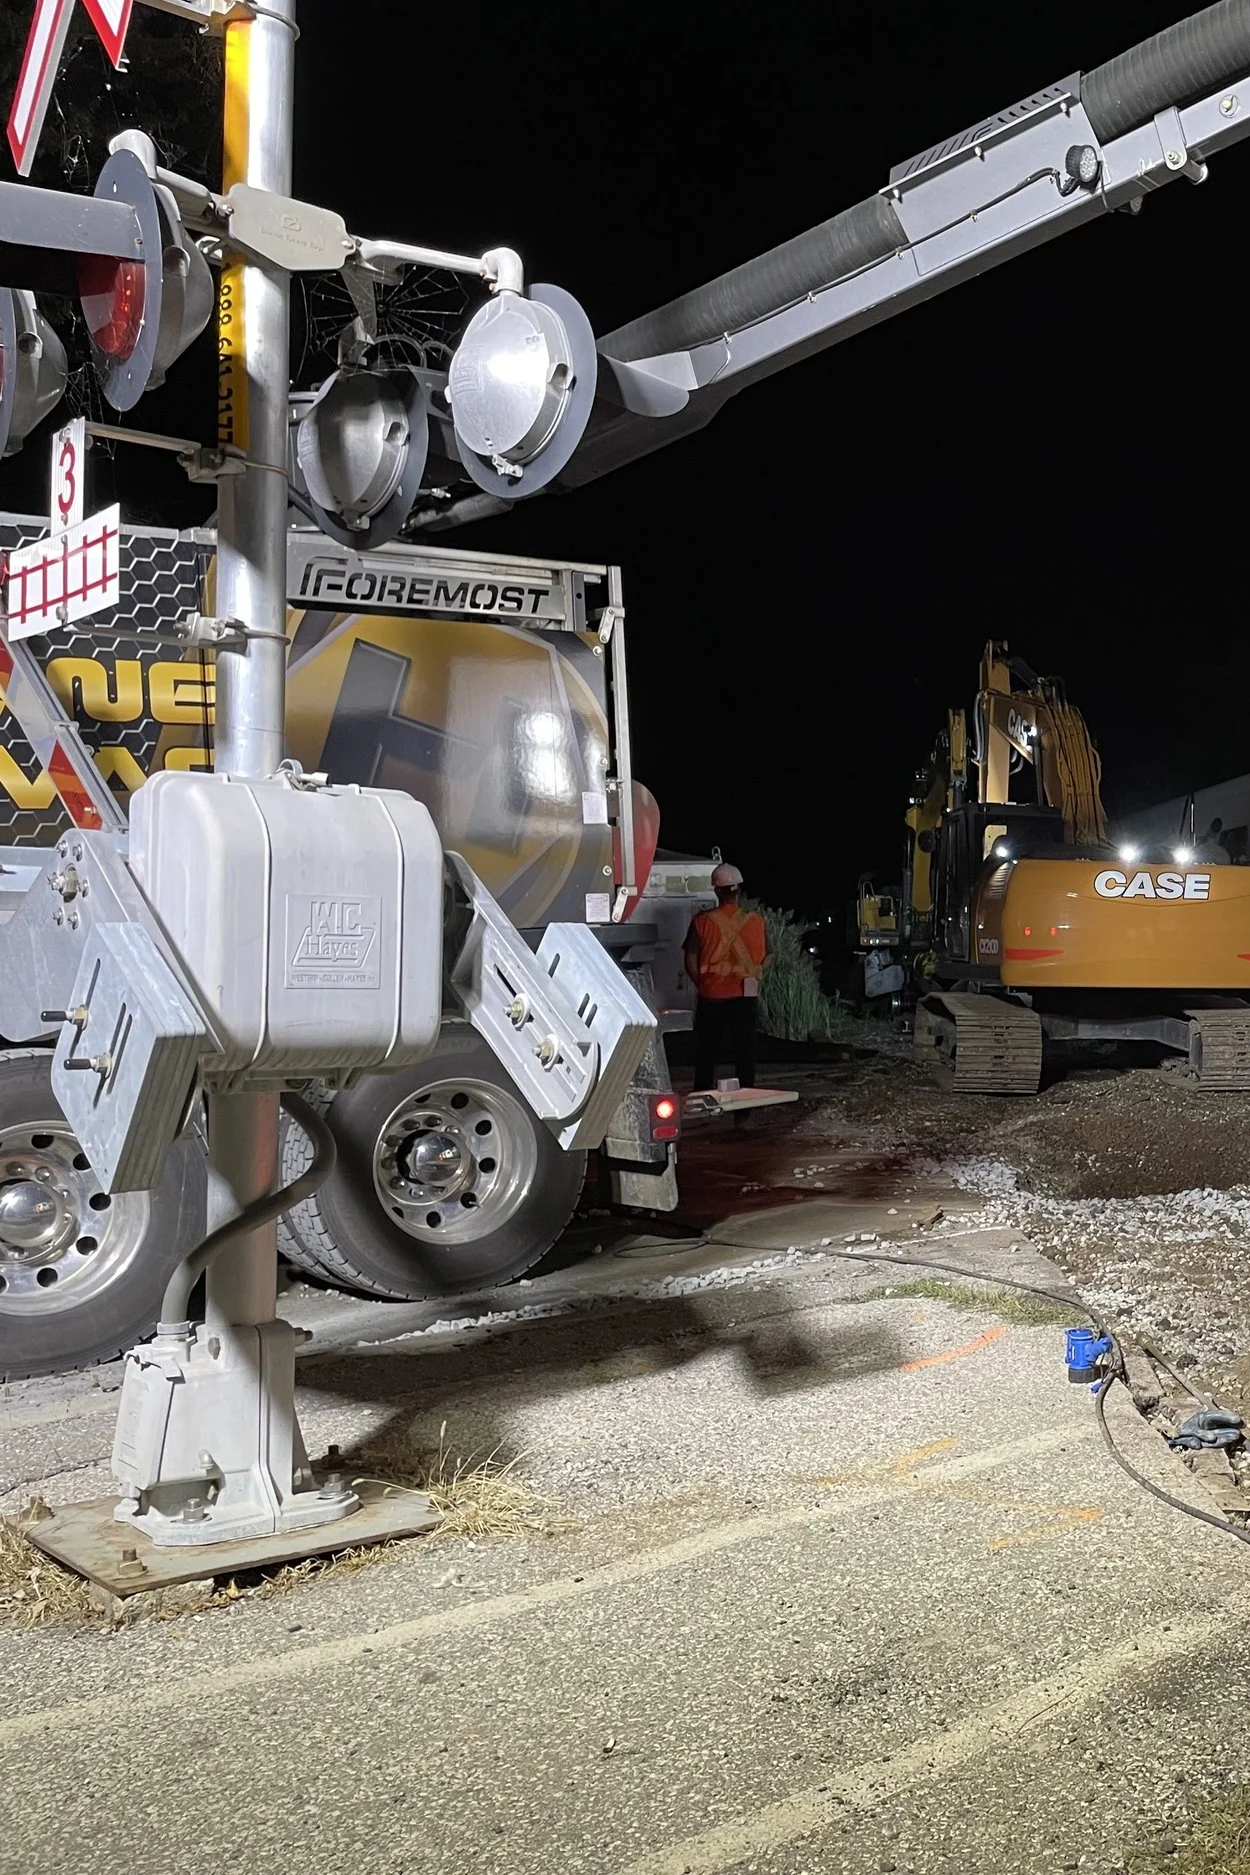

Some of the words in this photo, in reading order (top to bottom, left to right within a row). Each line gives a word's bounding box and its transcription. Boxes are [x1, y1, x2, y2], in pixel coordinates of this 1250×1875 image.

[58, 438, 76, 514] 3
[299, 556, 550, 614] FOREMOST
[1093, 869, 1211, 900] CASE
[305, 934, 359, 963] Hayes
